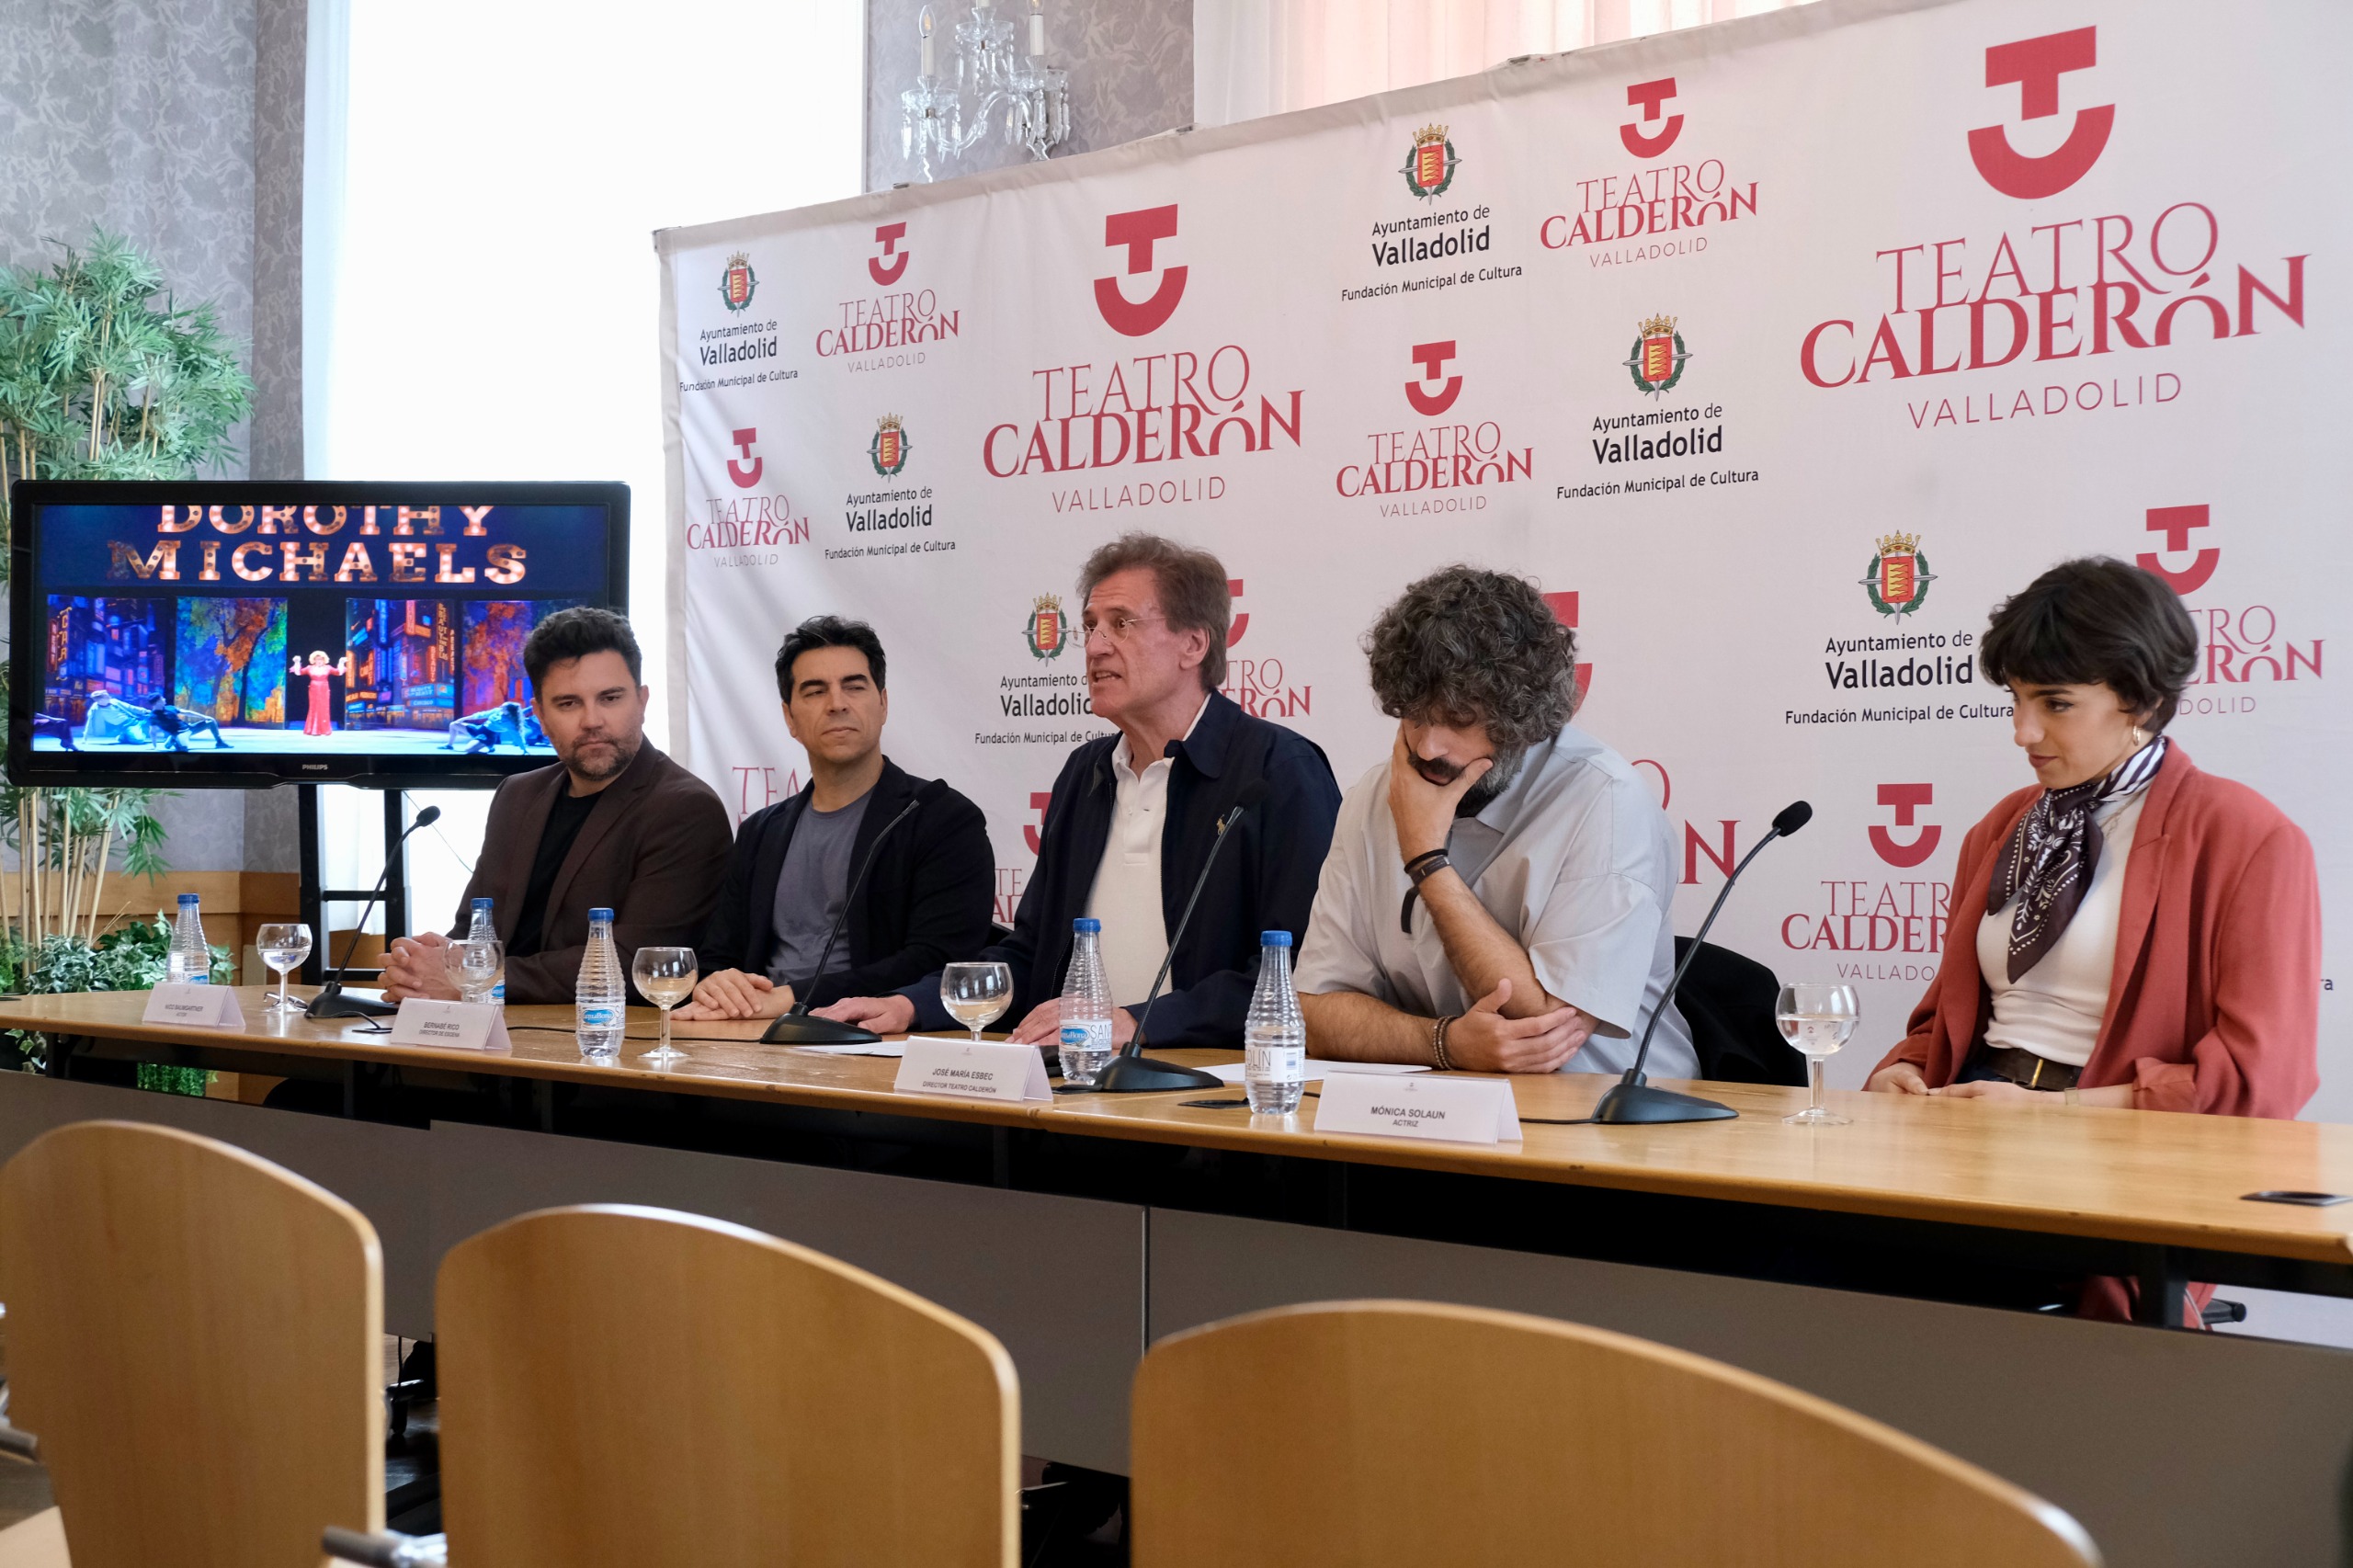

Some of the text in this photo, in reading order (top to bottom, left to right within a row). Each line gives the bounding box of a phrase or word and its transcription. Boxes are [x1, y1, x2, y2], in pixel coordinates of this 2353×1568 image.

[1576, 159, 1724, 212] TEATRO
[1372, 204, 1490, 237] Ayuntamiento de
[1540, 182, 1759, 249] CALDERÓN
[1371, 225, 1490, 267] Valladolid
[1590, 237, 1708, 267] VALLADOLID
[1875, 201, 2218, 314] TEATRO
[1342, 266, 1522, 301] Fundación Municipal de Cultura
[839, 289, 936, 328] TEATRO
[1800, 254, 2313, 388] CALDERÓN
[699, 319, 778, 341] Ayuntamiento de
[816, 310, 961, 358] CALDERÓN
[699, 336, 778, 366] Valladolid
[847, 352, 926, 373] VALLADOLID
[679, 369, 798, 392] Fundación Municipal de Cultura
[1032, 345, 1250, 422] TEATRO
[1907, 372, 2181, 429] VALLADOLID
[983, 390, 1306, 478] CALDERÓN
[1593, 403, 1722, 434] Ayuntamiento de
[1368, 421, 1501, 465] TEATRO
[1592, 426, 1722, 464] Valladolid
[1336, 448, 1534, 497] CALDERÓN
[1557, 470, 1759, 499] Fundación Municipal de Cultura
[706, 494, 790, 526] TEATRO
[847, 486, 932, 506] Ayuntamiento de
[1051, 476, 1225, 513] VALLADOLID
[1380, 495, 1487, 517] VALLADOLID
[687, 517, 810, 550] CALDERÓN
[846, 505, 932, 532] Valladolid
[106, 540, 527, 584] MICHAELS
[713, 553, 779, 567] VALLADOLID
[825, 540, 956, 560] Fundación Municipal de Cultura
[1824, 630, 1972, 656] Ayuntamiento de
[1000, 674, 1077, 690] Ayuntamiento
[1226, 658, 1283, 697] TRO
[1824, 654, 1972, 689] Valladolid
[1785, 703, 2014, 724] Fundación Municipal de Cultura
[2178, 697, 2256, 715] DOLID
[975, 732, 1021, 744] Fundación
[1023, 731, 1067, 745] Municipal
[1070, 732, 1083, 743] de
[1821, 881, 1950, 919] TEATR
[1781, 913, 1948, 953] CALDER
[1836, 963, 1935, 982] VALLADO
[424, 1021, 447, 1029] BERNABÉ
[932, 1068, 993, 1080] JOSÉ MARÍA ESBEC
[948, 1083, 967, 1091] TEATRO
[969, 1085, 996, 1093] CALDERÓN
[1370, 1106, 1445, 1119] MÓNICA SOLAUN
[1392, 1119, 1418, 1128] ACTRIZ
